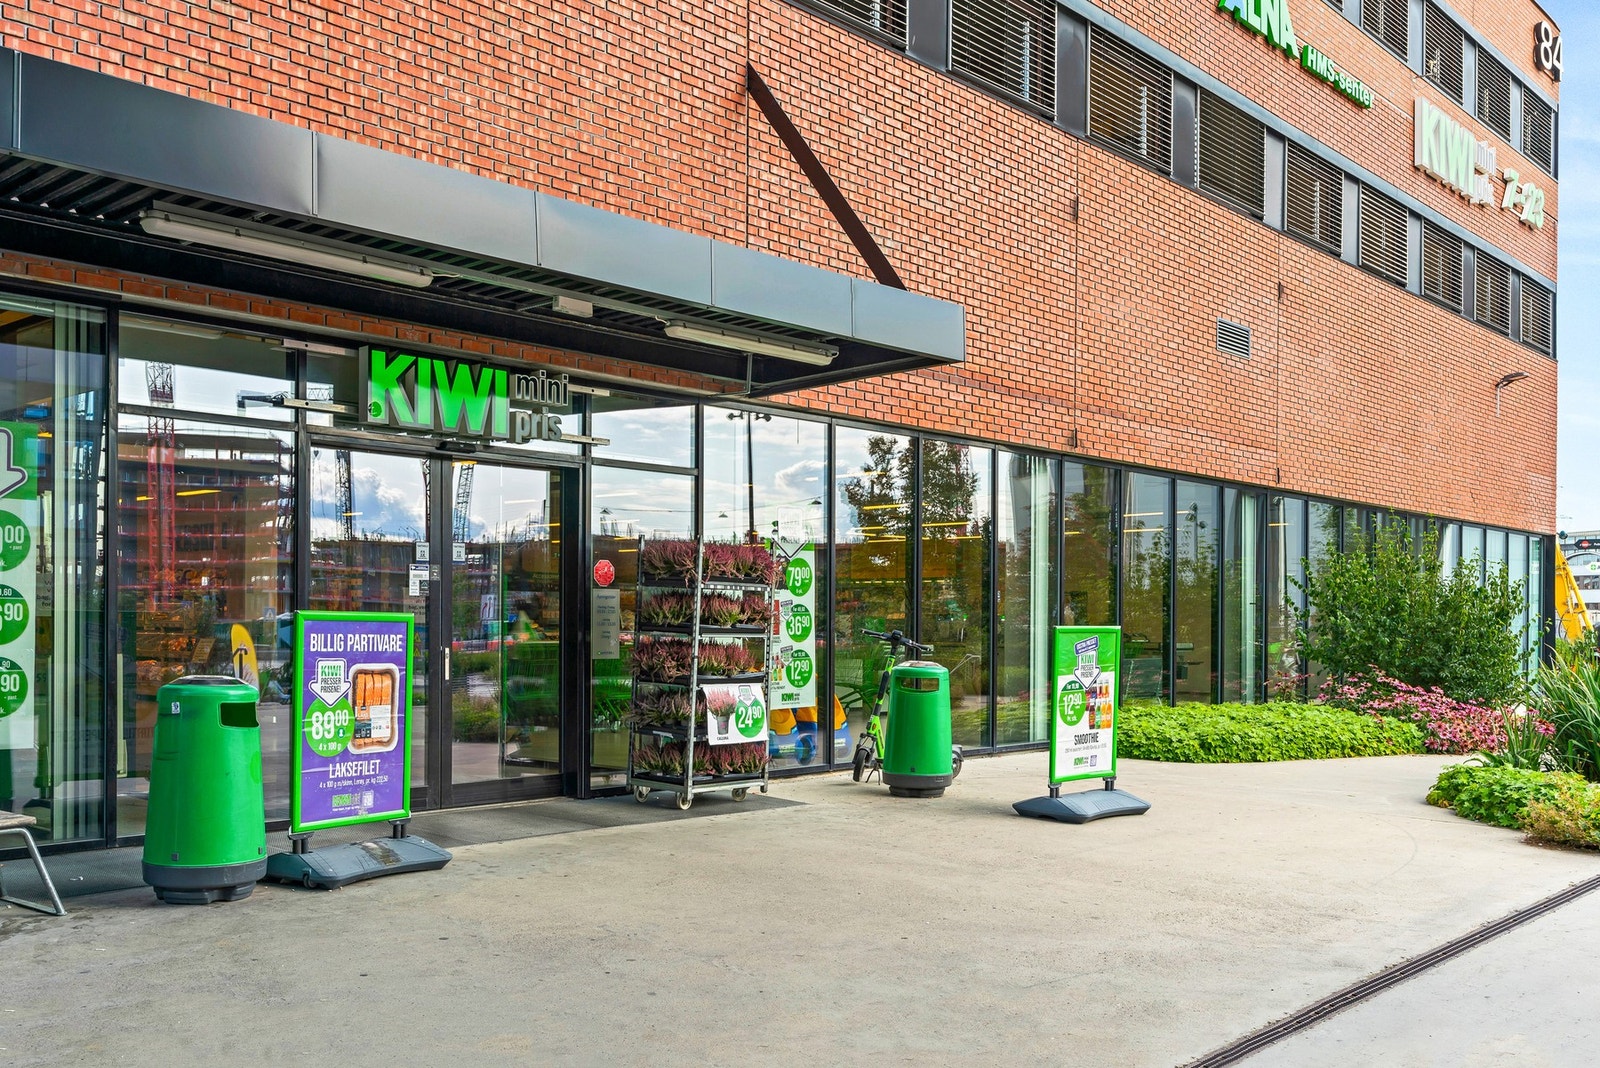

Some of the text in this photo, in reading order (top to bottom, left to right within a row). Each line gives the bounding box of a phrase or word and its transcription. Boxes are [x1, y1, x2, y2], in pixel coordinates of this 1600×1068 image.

[1218, 0, 1300, 60] LNA
[1536, 21, 1563, 82] 84
[1304, 45, 1375, 108] HMS-senter
[1416, 97, 1476, 202] KIWI
[1502, 168, 1545, 228] 7-23
[367, 350, 510, 438] KIWI
[516, 370, 569, 406] mini
[514, 408, 562, 443] pris
[0, 588, 12, 596] ,60
[310, 634, 403, 652] BILLIG PARTIVARE
[321, 665, 341, 676] KIWI
[321, 677, 341, 685] PRESSER
[320, 685, 341, 693] PRISENE!
[319, 743, 323, 751] 4
[1074, 732, 1099, 745] SMOOTHIE
[329, 760, 381, 778] LAKSEFILET
